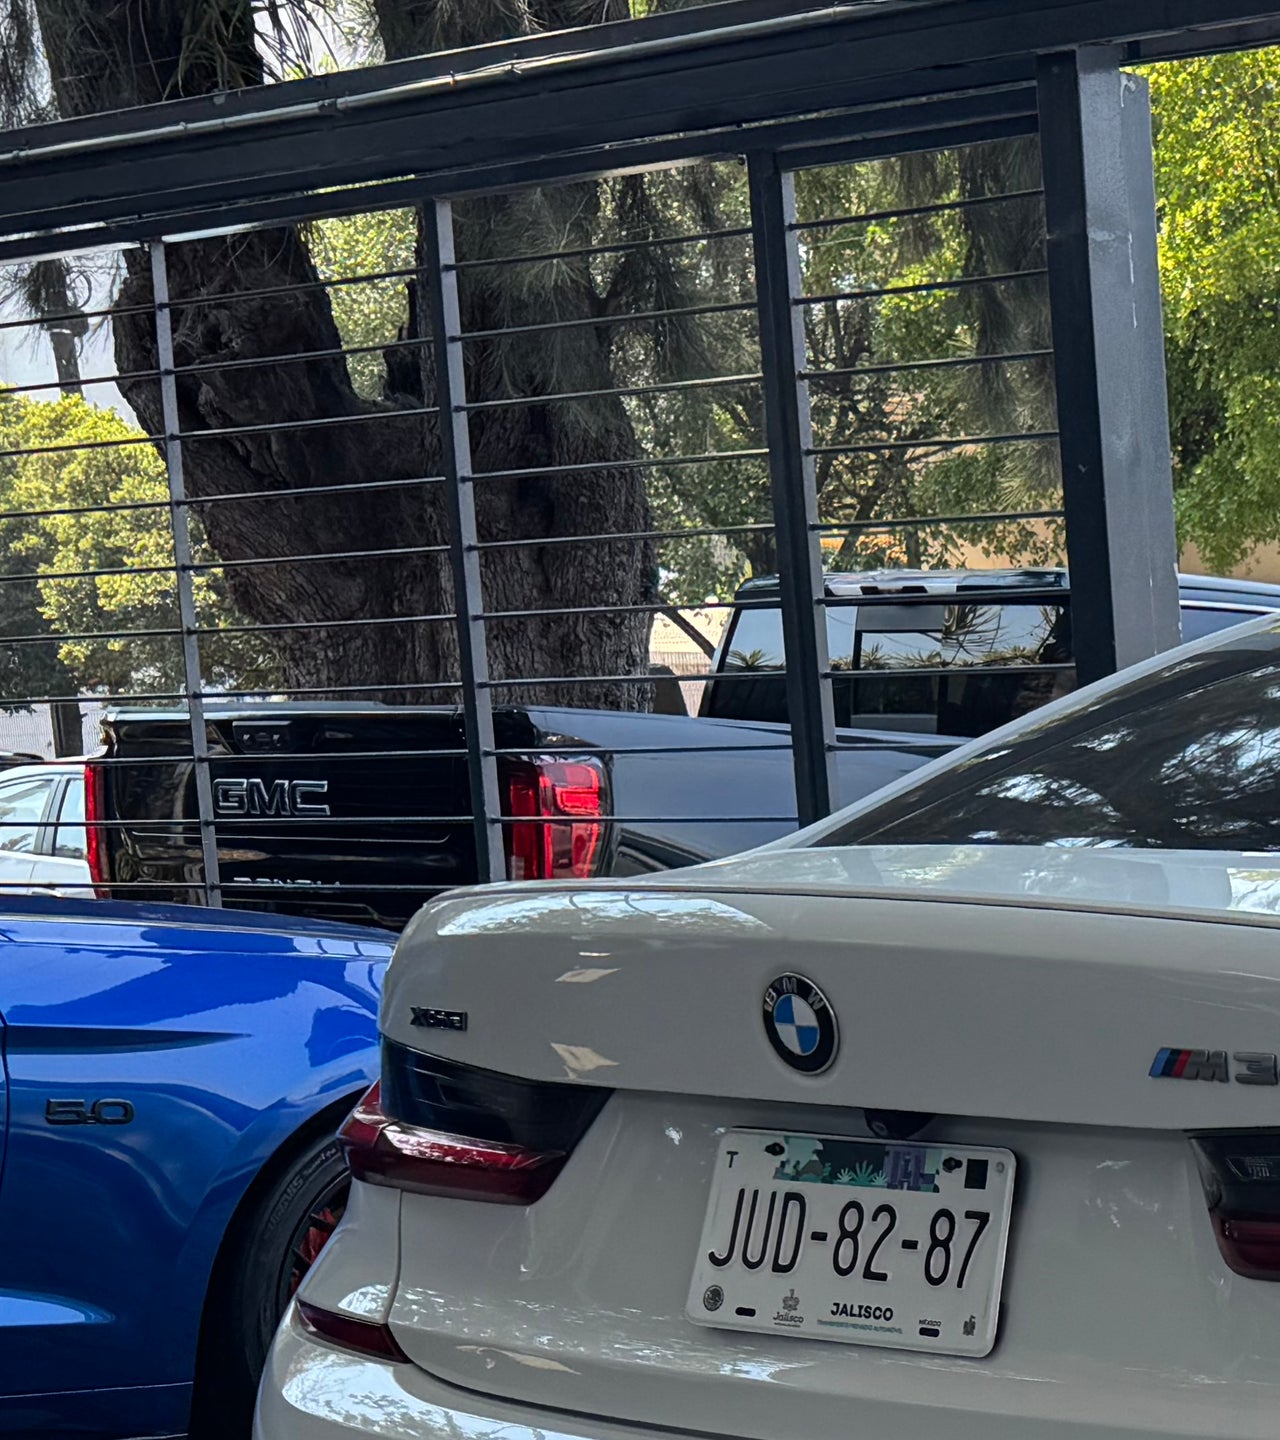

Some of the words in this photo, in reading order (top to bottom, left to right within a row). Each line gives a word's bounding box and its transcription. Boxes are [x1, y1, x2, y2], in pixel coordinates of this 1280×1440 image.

[213, 778, 331, 816] GMC
[763, 977, 826, 1012] BMW
[45, 1098, 134, 1126] 5.0
[708, 1187, 991, 1288] JUD-82-87
[830, 1302, 894, 1322] JALISCO
